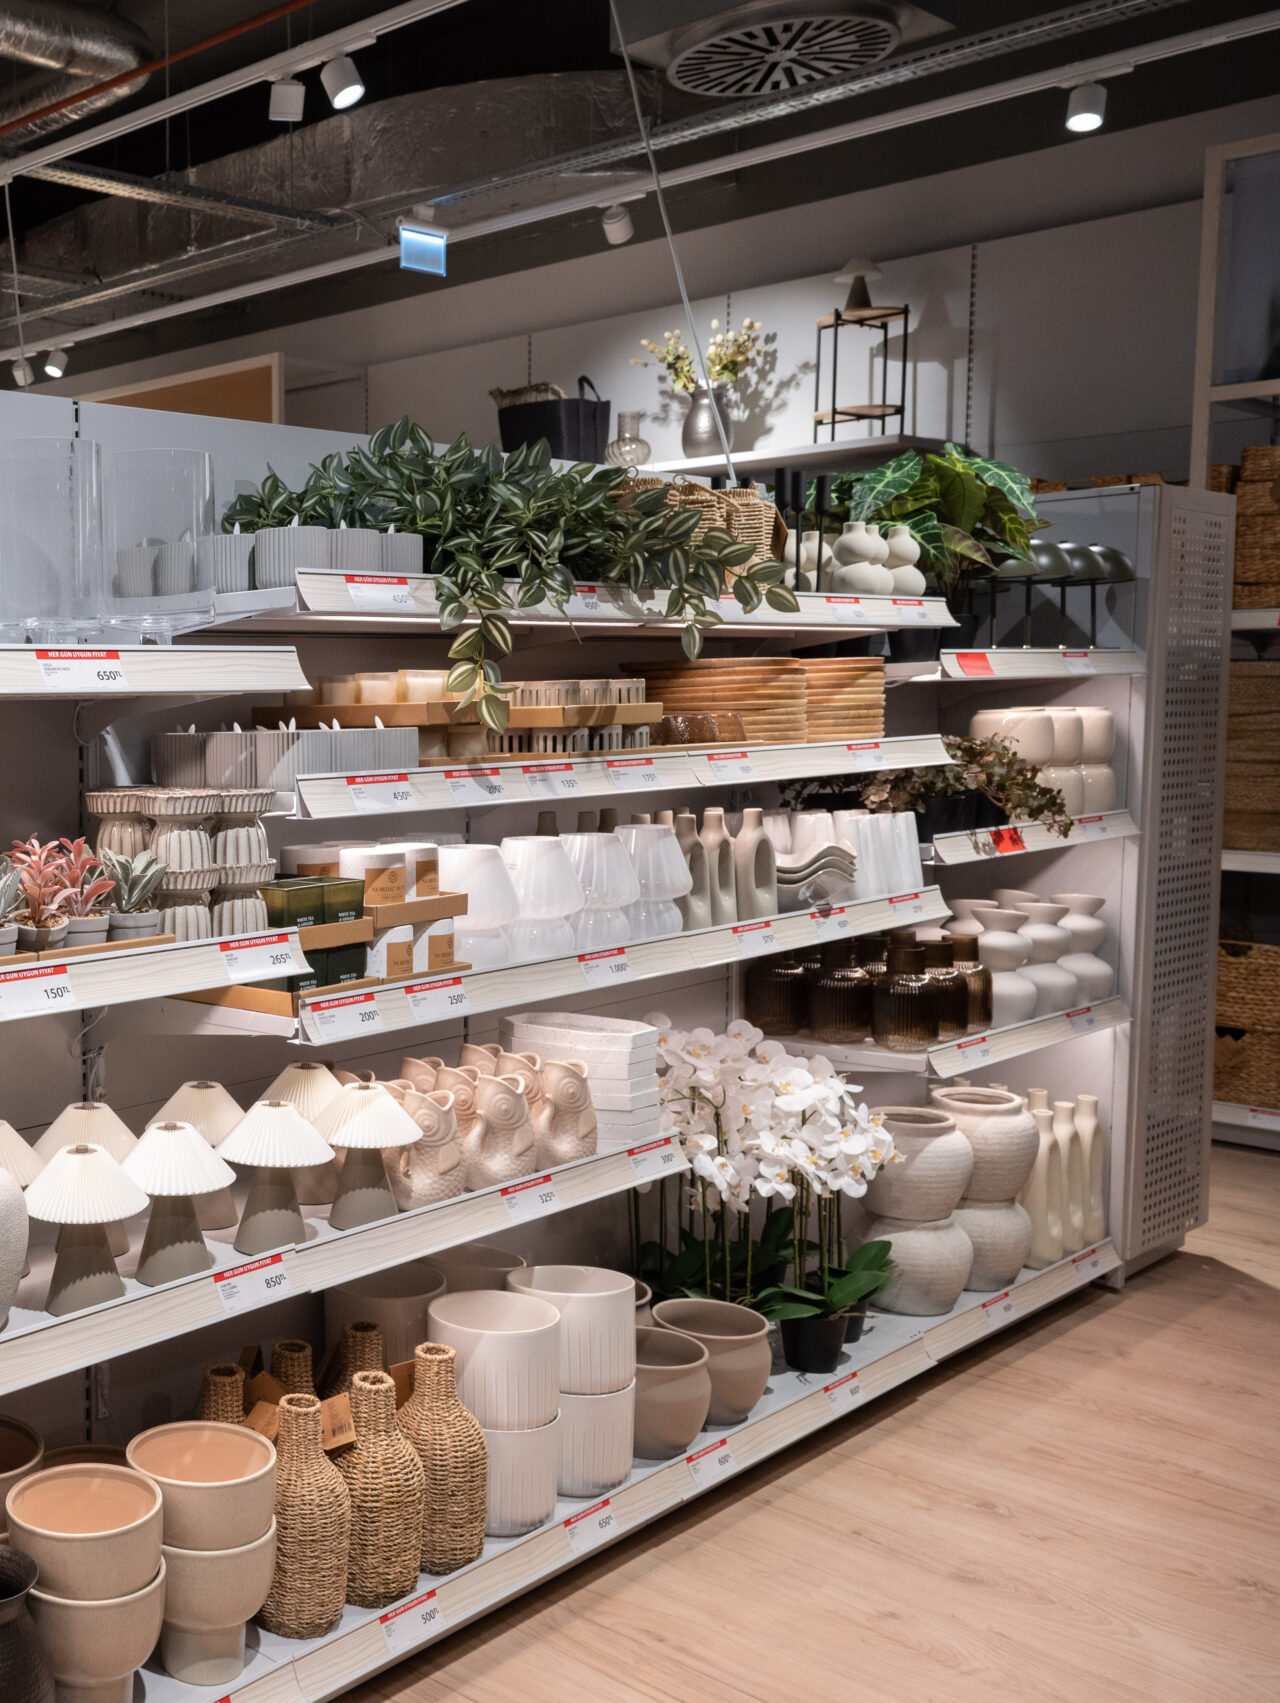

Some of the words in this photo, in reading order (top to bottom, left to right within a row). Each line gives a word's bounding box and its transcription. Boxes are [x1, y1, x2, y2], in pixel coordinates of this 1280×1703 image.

[97, 670, 123, 680] 650TL
[269, 953, 292, 965] 265TL
[19, 969, 39, 978] UYGUN
[44, 986, 70, 999] 150TL
[359, 1010, 379, 1022] 200TL
[264, 1274, 286, 1289] 850TL
[421, 1608, 439, 1624] 500TL
